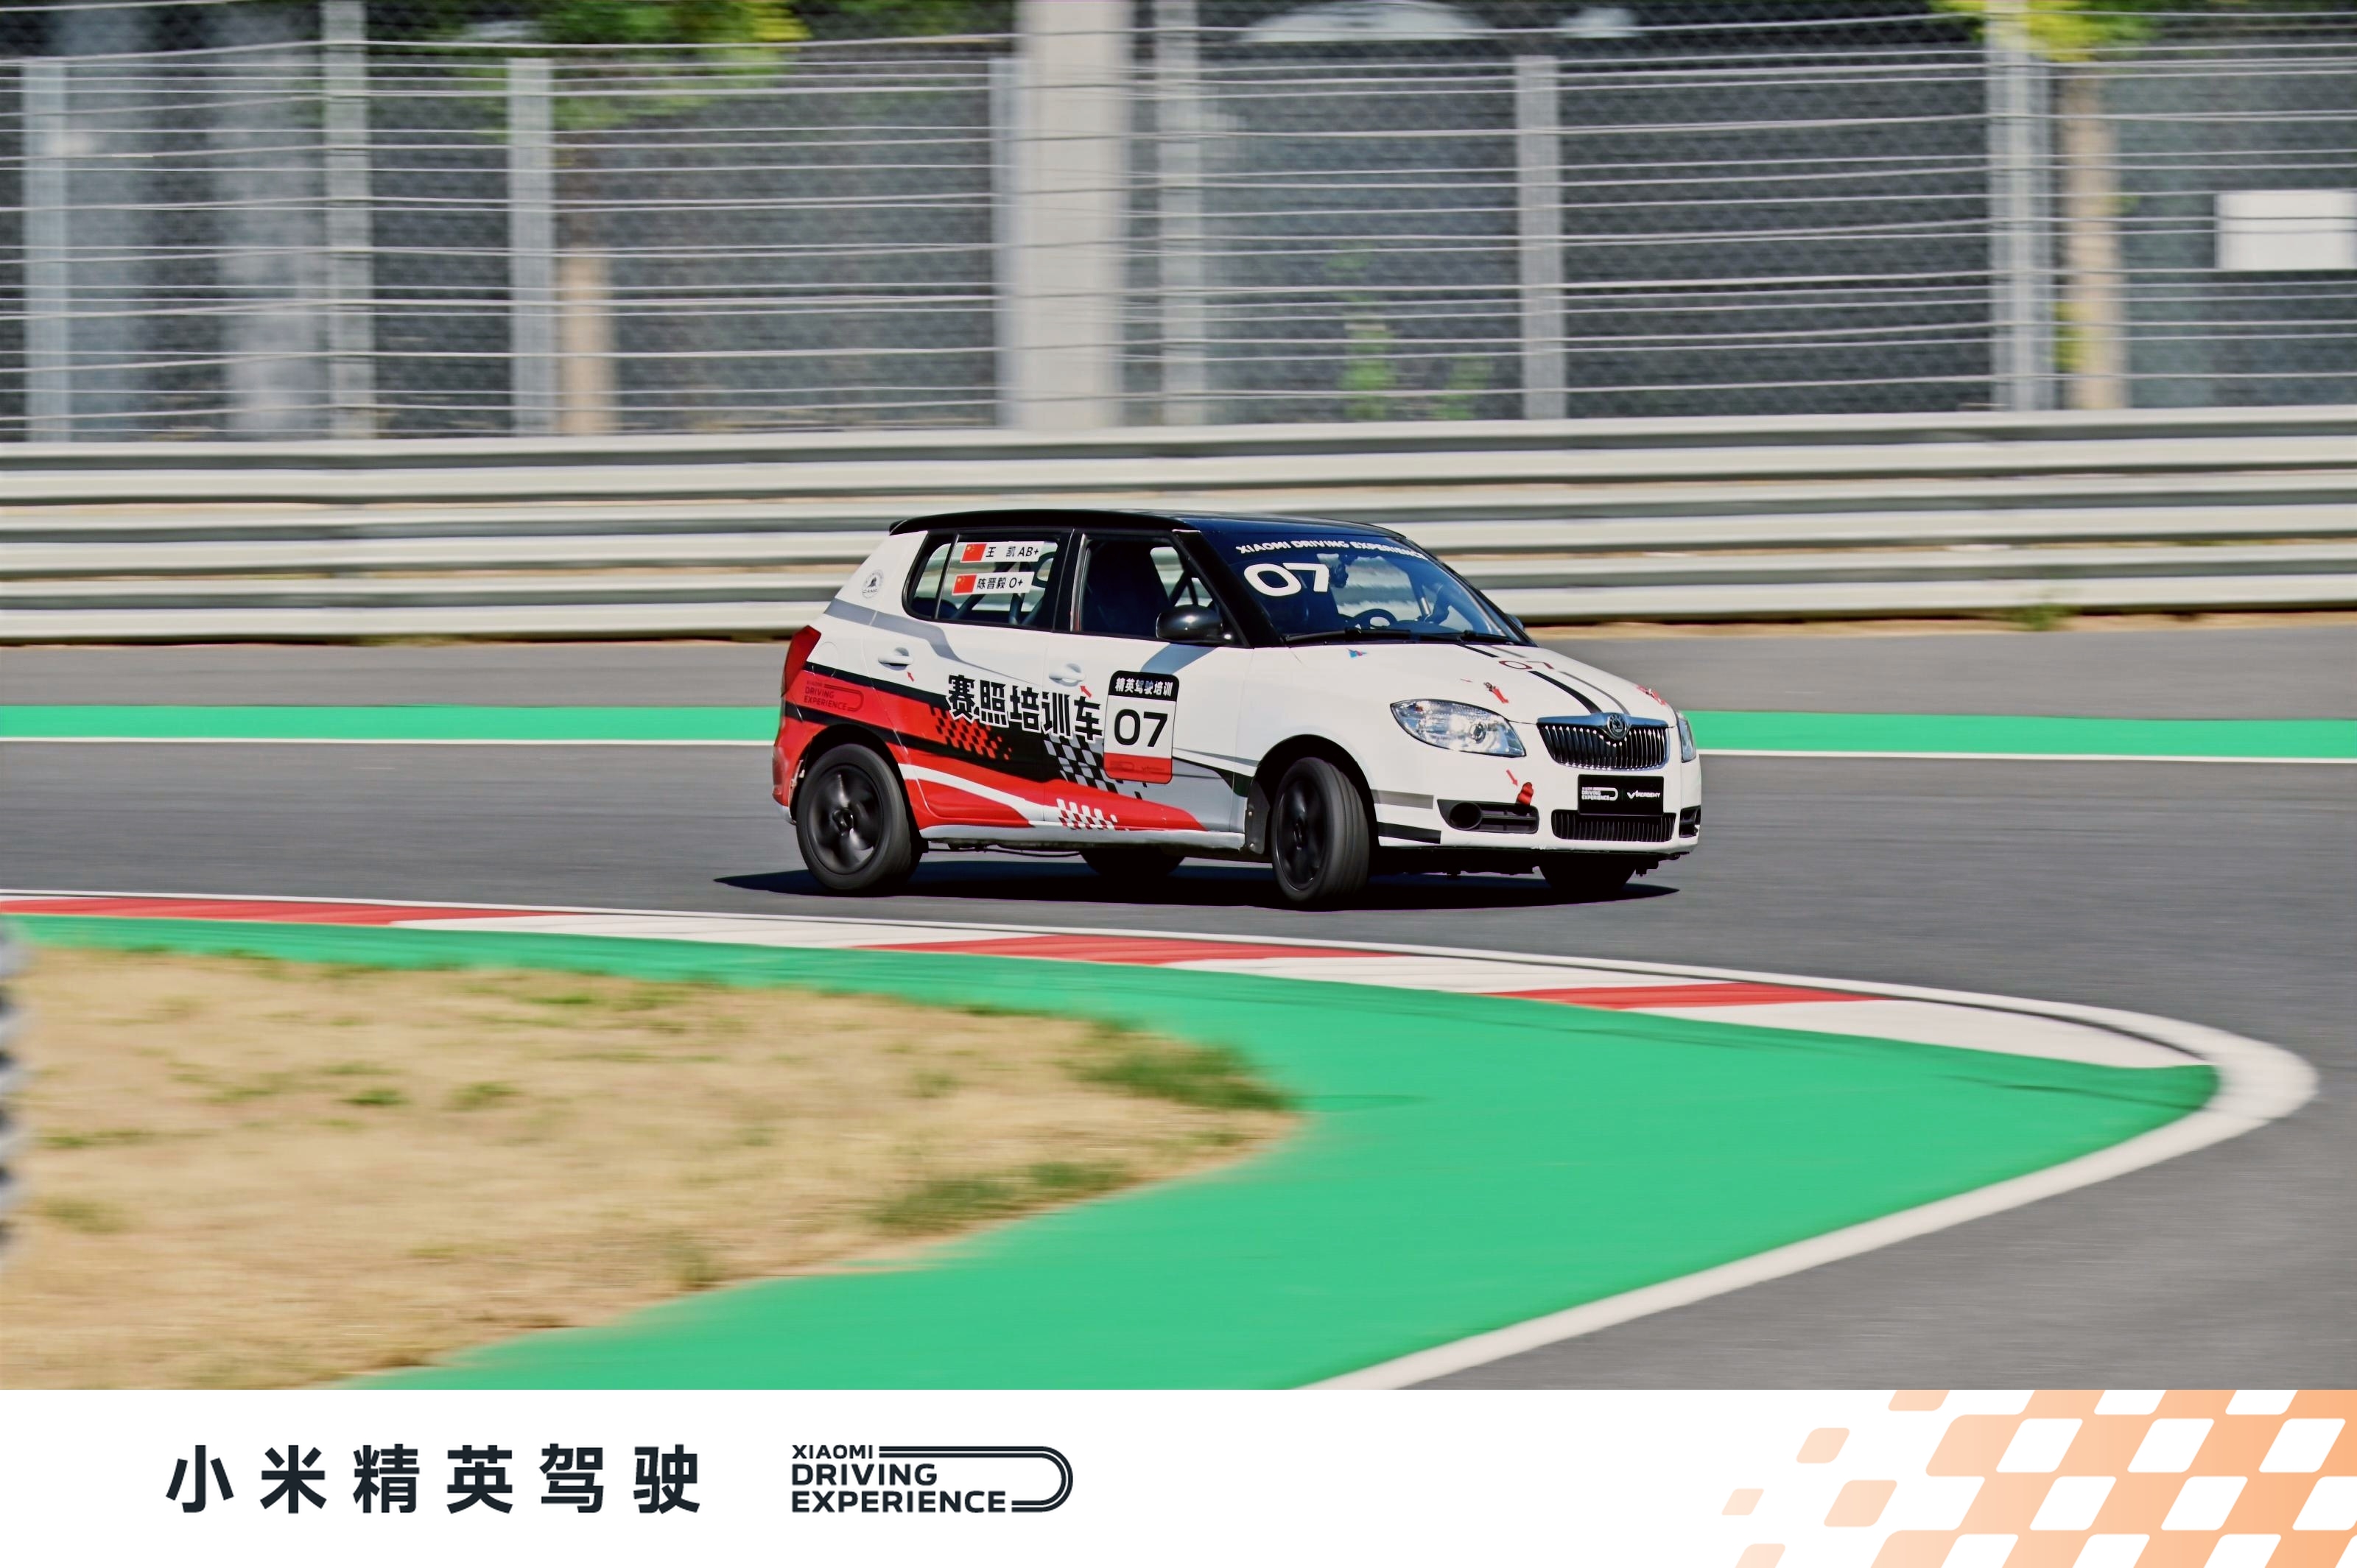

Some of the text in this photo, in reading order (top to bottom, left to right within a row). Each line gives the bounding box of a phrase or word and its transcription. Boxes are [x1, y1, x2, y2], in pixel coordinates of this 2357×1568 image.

[1017, 546, 1039, 557] AB+
[1236, 541, 1290, 554] XIAOMI
[1290, 540, 1349, 549] DRIVING
[1243, 562, 1329, 597] 07
[805, 686, 835, 699] DRIVING
[1114, 677, 1173, 697] 精英驾驶培训
[804, 695, 847, 711] EXPERIENCE
[948, 674, 1104, 742] 赛照培训车
[1114, 709, 1168, 748] 07
